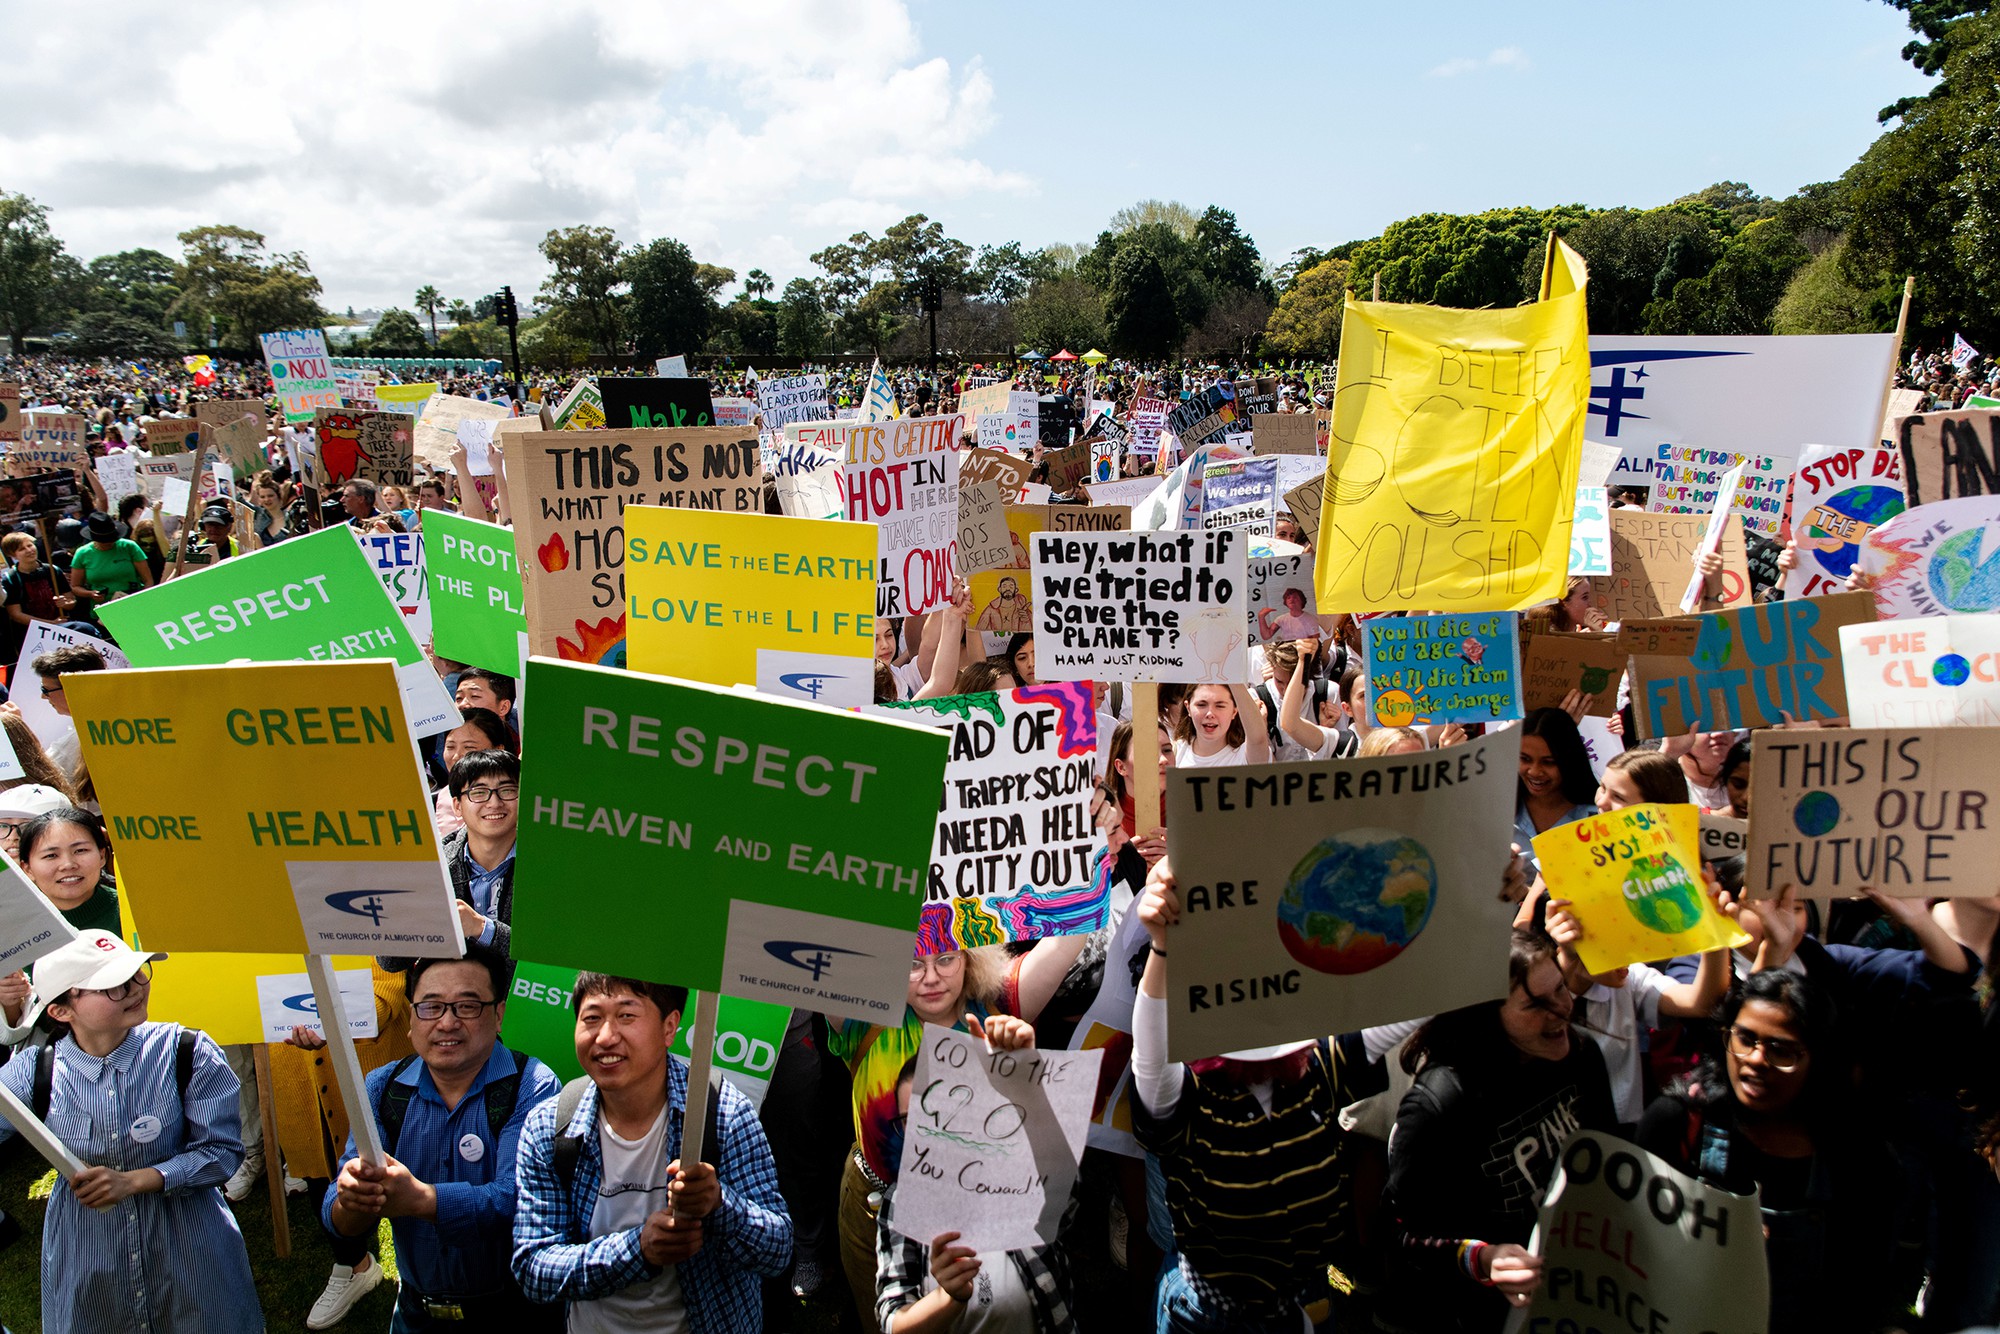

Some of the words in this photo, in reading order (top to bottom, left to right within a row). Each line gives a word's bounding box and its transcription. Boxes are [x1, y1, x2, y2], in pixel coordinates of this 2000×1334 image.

[1370, 329, 1394, 381] I
[289, 360, 327, 379] NOW
[757, 380, 780, 394] WE
[782, 377, 808, 389] NEED
[813, 376, 822, 386] A
[1238, 386, 1256, 398] DONT
[289, 392, 339, 412] LATER
[760, 393, 798, 411] LEADER
[1137, 397, 1165, 413] SYSTEM
[1245, 392, 1275, 405] PRIVATISE
[1246, 403, 1271, 415] OUR
[366, 421, 399, 432] SPEAKS
[629, 402, 708, 428] Make
[762, 406, 799, 430] CLIMATE
[982, 418, 1003, 428] CUT
[846, 426, 886, 464] IT'S
[894, 415, 966, 458] GETTING
[982, 429, 1001, 438] THE
[1180, 427, 1201, 447] TALK
[1271, 439, 1289, 449] FOR
[367, 441, 395, 453] TREES
[1091, 440, 1118, 462] STOP
[378, 460, 396, 468] TREES
[390, 468, 413, 486] YOU
[545, 442, 640, 491] THIS
[653, 443, 689, 483] IS
[702, 439, 760, 480] NOT
[1205, 466, 1230, 478] green
[1800, 448, 1865, 496] STOP
[849, 463, 908, 521] HOT
[911, 455, 946, 486] IN
[911, 484, 957, 511] HERE
[1207, 488, 1226, 499] We
[1230, 484, 1262, 497] need
[1657, 483, 1689, 502] BUT
[540, 494, 609, 522] WHAT
[658, 487, 727, 510] MEANT
[735, 486, 763, 512] BY
[977, 501, 995, 515] OUT
[883, 516, 924, 552] TAKE
[929, 510, 958, 543] OFF
[1055, 513, 1122, 532] STAYING
[1204, 507, 1266, 530] climate
[1814, 506, 1859, 540] THE
[1107, 533, 1194, 563] what
[1205, 531, 1233, 564] if
[1909, 519, 1952, 550] WE
[629, 537, 722, 569] SAVE
[729, 555, 770, 572] THE
[772, 552, 875, 581] EARTH
[958, 547, 1010, 574] USELESS
[1325, 522, 1428, 603] YOU
[1613, 560, 1632, 573] OR
[435, 574, 474, 598] THE
[1043, 575, 1096, 600] we
[1096, 567, 1192, 602] tried
[1196, 567, 1233, 604] to
[1593, 576, 1670, 599] EXPECT
[154, 573, 332, 651] RESPECT
[630, 595, 723, 627] LOVE
[732, 609, 773, 626] THE
[786, 610, 874, 638] LIFE
[1044, 599, 1116, 634] Save
[1123, 600, 1180, 628] the
[38, 625, 74, 646] TIME
[1062, 626, 1181, 650] PLANET?
[1371, 620, 1429, 648] you'll
[1438, 618, 1472, 638] die
[1478, 617, 1501, 637] of
[1626, 625, 1648, 633] There
[1658, 625, 1671, 633] NO
[307, 626, 398, 662] EARTH
[1377, 644, 1407, 662] old
[1414, 641, 1458, 662] age
[1648, 635, 1659, 651] B
[1860, 631, 1926, 656] THE
[1103, 653, 1136, 665] JUST
[1138, 654, 1184, 668] KIDDING
[1533, 656, 1568, 673] DON'T
[1372, 666, 1422, 688] we'll
[1426, 667, 1457, 687] die
[1461, 664, 1508, 686] from
[1529, 675, 1571, 688] POISON
[1373, 693, 1442, 718] climate
[1446, 692, 1511, 717] change
[1647, 662, 1840, 738] FUTUR
[86, 717, 176, 746] MORE
[225, 705, 396, 746] GREEN
[432, 713, 447, 724] GOD
[1012, 709, 1055, 755] OF
[581, 705, 879, 804] RESPECT
[1767, 738, 1868, 788] THIS
[1882, 736, 1921, 783] IS
[1186, 747, 1487, 813] TEMPERATURES
[1875, 789, 1988, 831] OUR
[112, 815, 202, 841] MORE
[247, 809, 423, 847] HEALTH
[532, 795, 694, 850] HEAVEN
[713, 834, 773, 863] AND
[786, 842, 920, 896] EARTH
[955, 854, 1024, 900] CITY
[1030, 844, 1093, 887] OUT
[1766, 834, 1955, 891] FUTURE
[1187, 879, 1260, 914] ARE
[31, 929, 52, 945] GOD
[318, 932, 335, 940] THE
[335, 932, 370, 941] CHURCH
[371, 933, 382, 941] OF
[384, 934, 427, 943] ALMIGHTY
[426, 935, 445, 943] GOD
[512, 976, 575, 1011] BEST
[739, 974, 758, 985] THE
[759, 979, 801, 993] CHURCH
[802, 986, 816, 996] OF
[817, 989, 868, 1007] ALMIGHTY
[868, 999, 891, 1012] GOD
[1188, 969, 1302, 1013] RISING
[934, 1037, 968, 1069] GO
[988, 1052, 1017, 1078] TO
[1027, 1058, 1076, 1085] THE
[1513, 1096, 1582, 1196] PINK
[909, 1143, 944, 1179] You
[1562, 1136, 1730, 1247] OOOH
[1548, 1210, 1648, 1281] HELL
